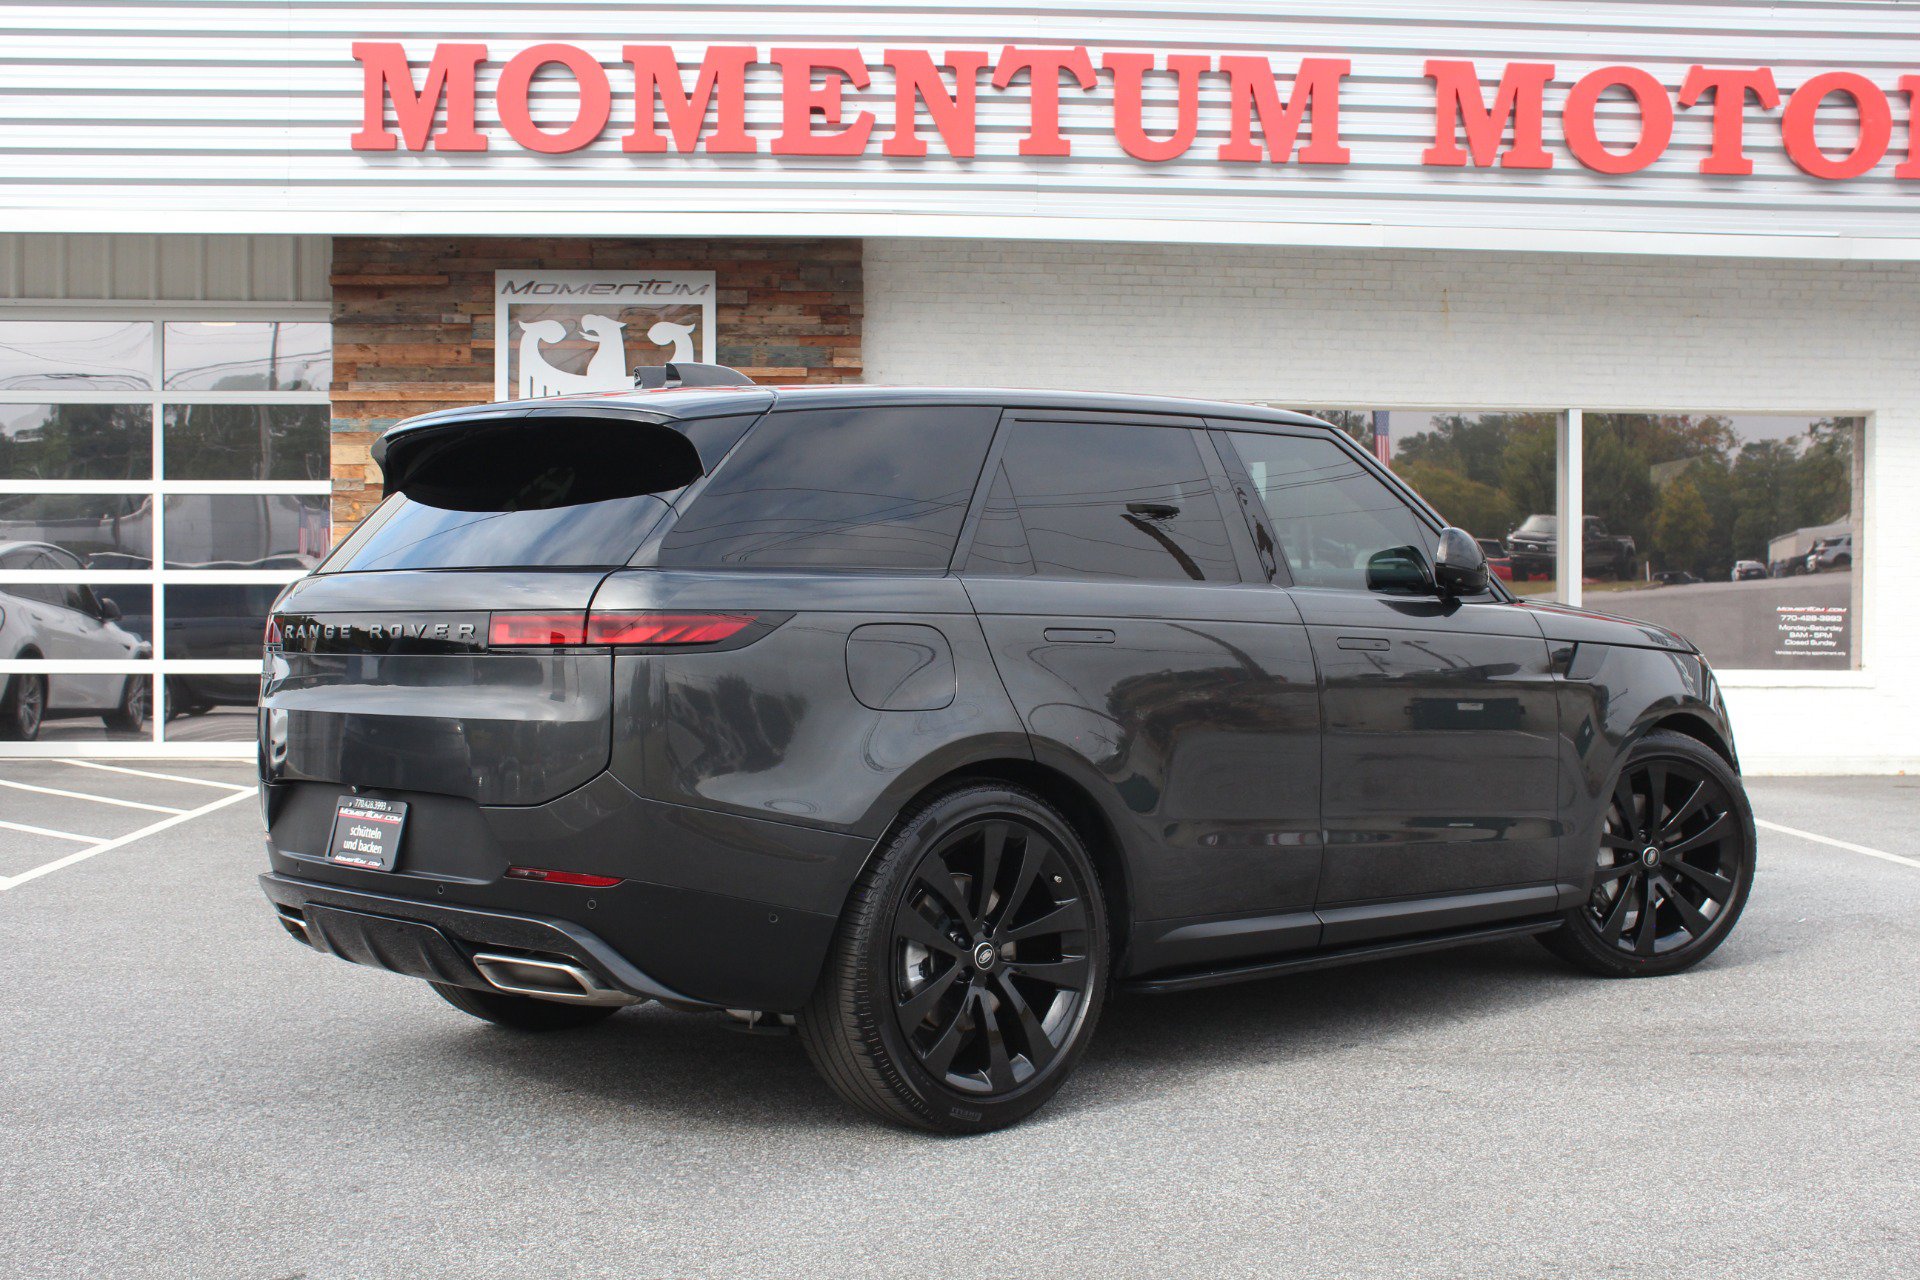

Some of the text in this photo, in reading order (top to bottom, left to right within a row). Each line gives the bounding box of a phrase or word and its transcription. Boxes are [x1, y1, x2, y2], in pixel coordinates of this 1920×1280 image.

[351, 42, 1920, 180] MOMENTUM MOTO
[284, 623, 476, 639] RANGE ROVER
[1779, 624, 1843, 632] Monday-Saturday
[1810, 639, 1837, 647] Sunday
[349, 825, 382, 839] schütteln
[343, 839, 383, 854] und backen
